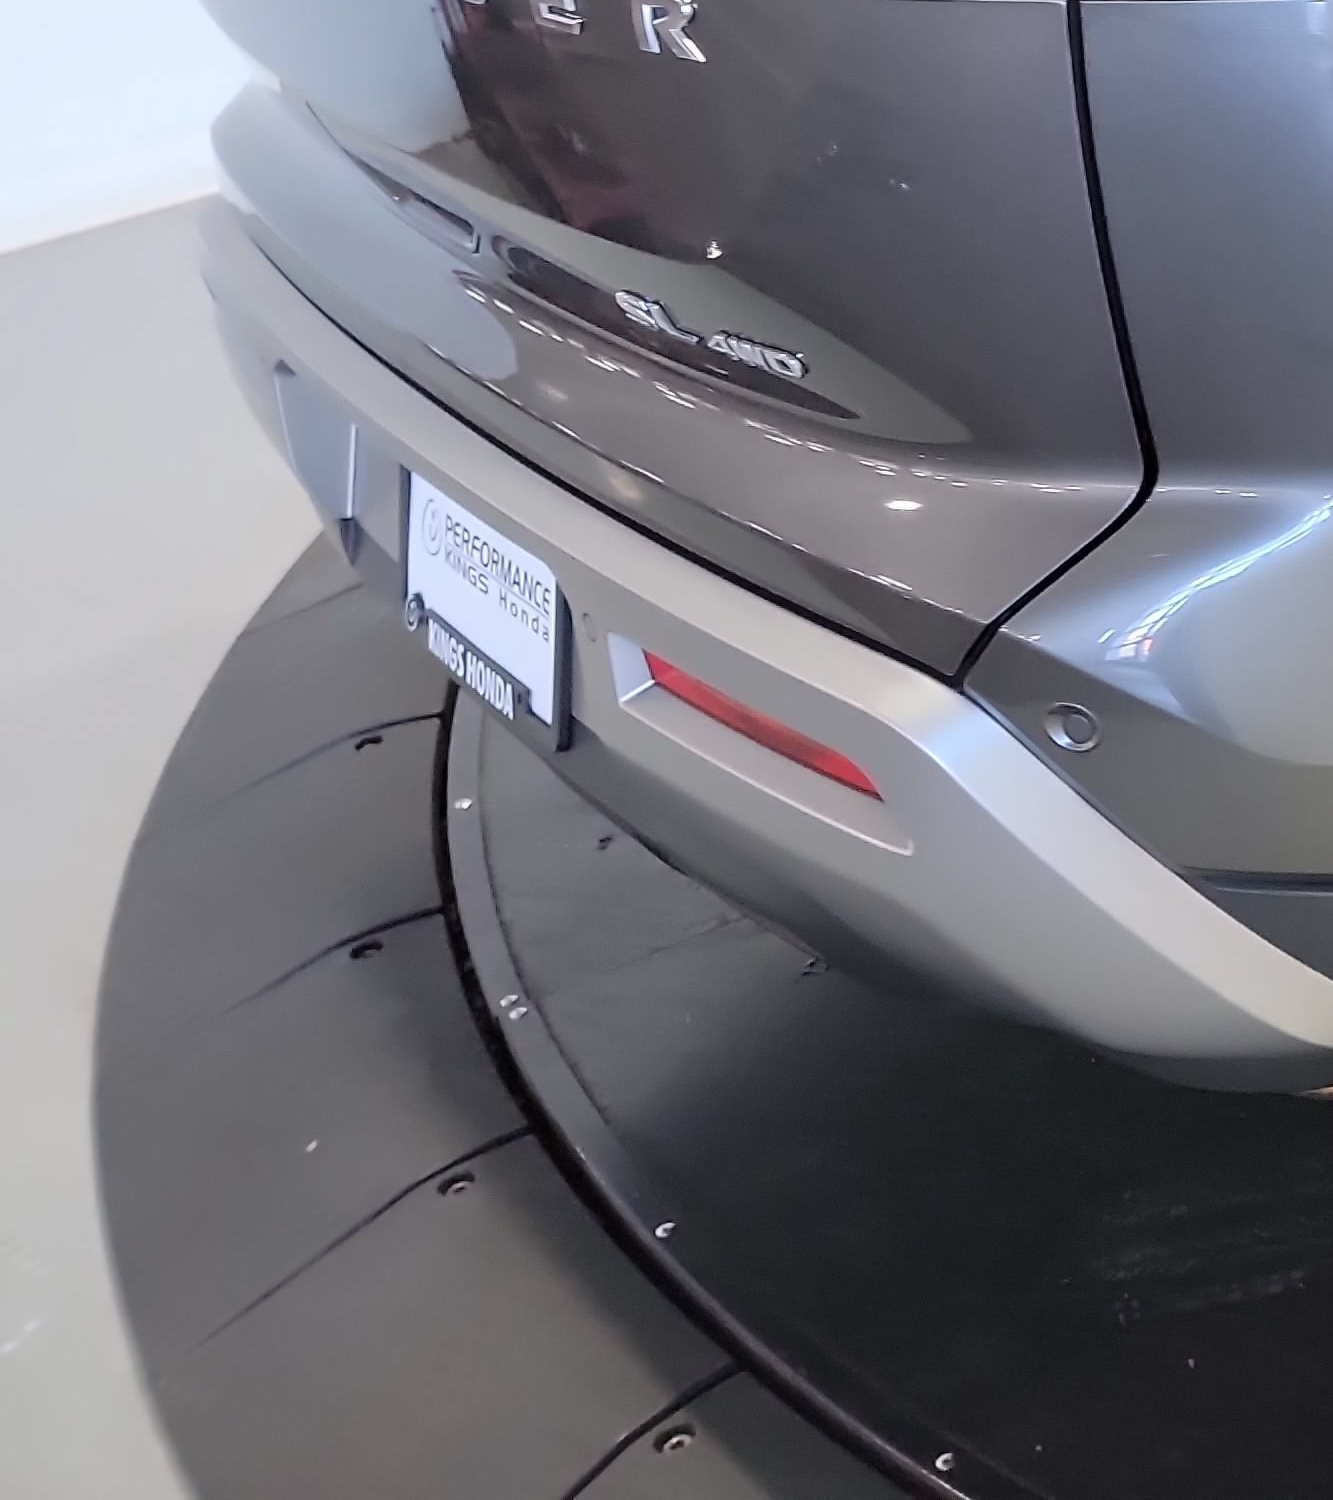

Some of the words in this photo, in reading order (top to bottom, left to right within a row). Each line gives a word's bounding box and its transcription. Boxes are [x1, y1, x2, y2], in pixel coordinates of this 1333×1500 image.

[615, 289, 704, 344] SL
[445, 549, 489, 595] KINGS
[499, 588, 550, 642] Honda
[446, 513, 551, 616] PERFORMANCE
[428, 617, 465, 678] KINGS
[466, 654, 515, 721] HONDA
